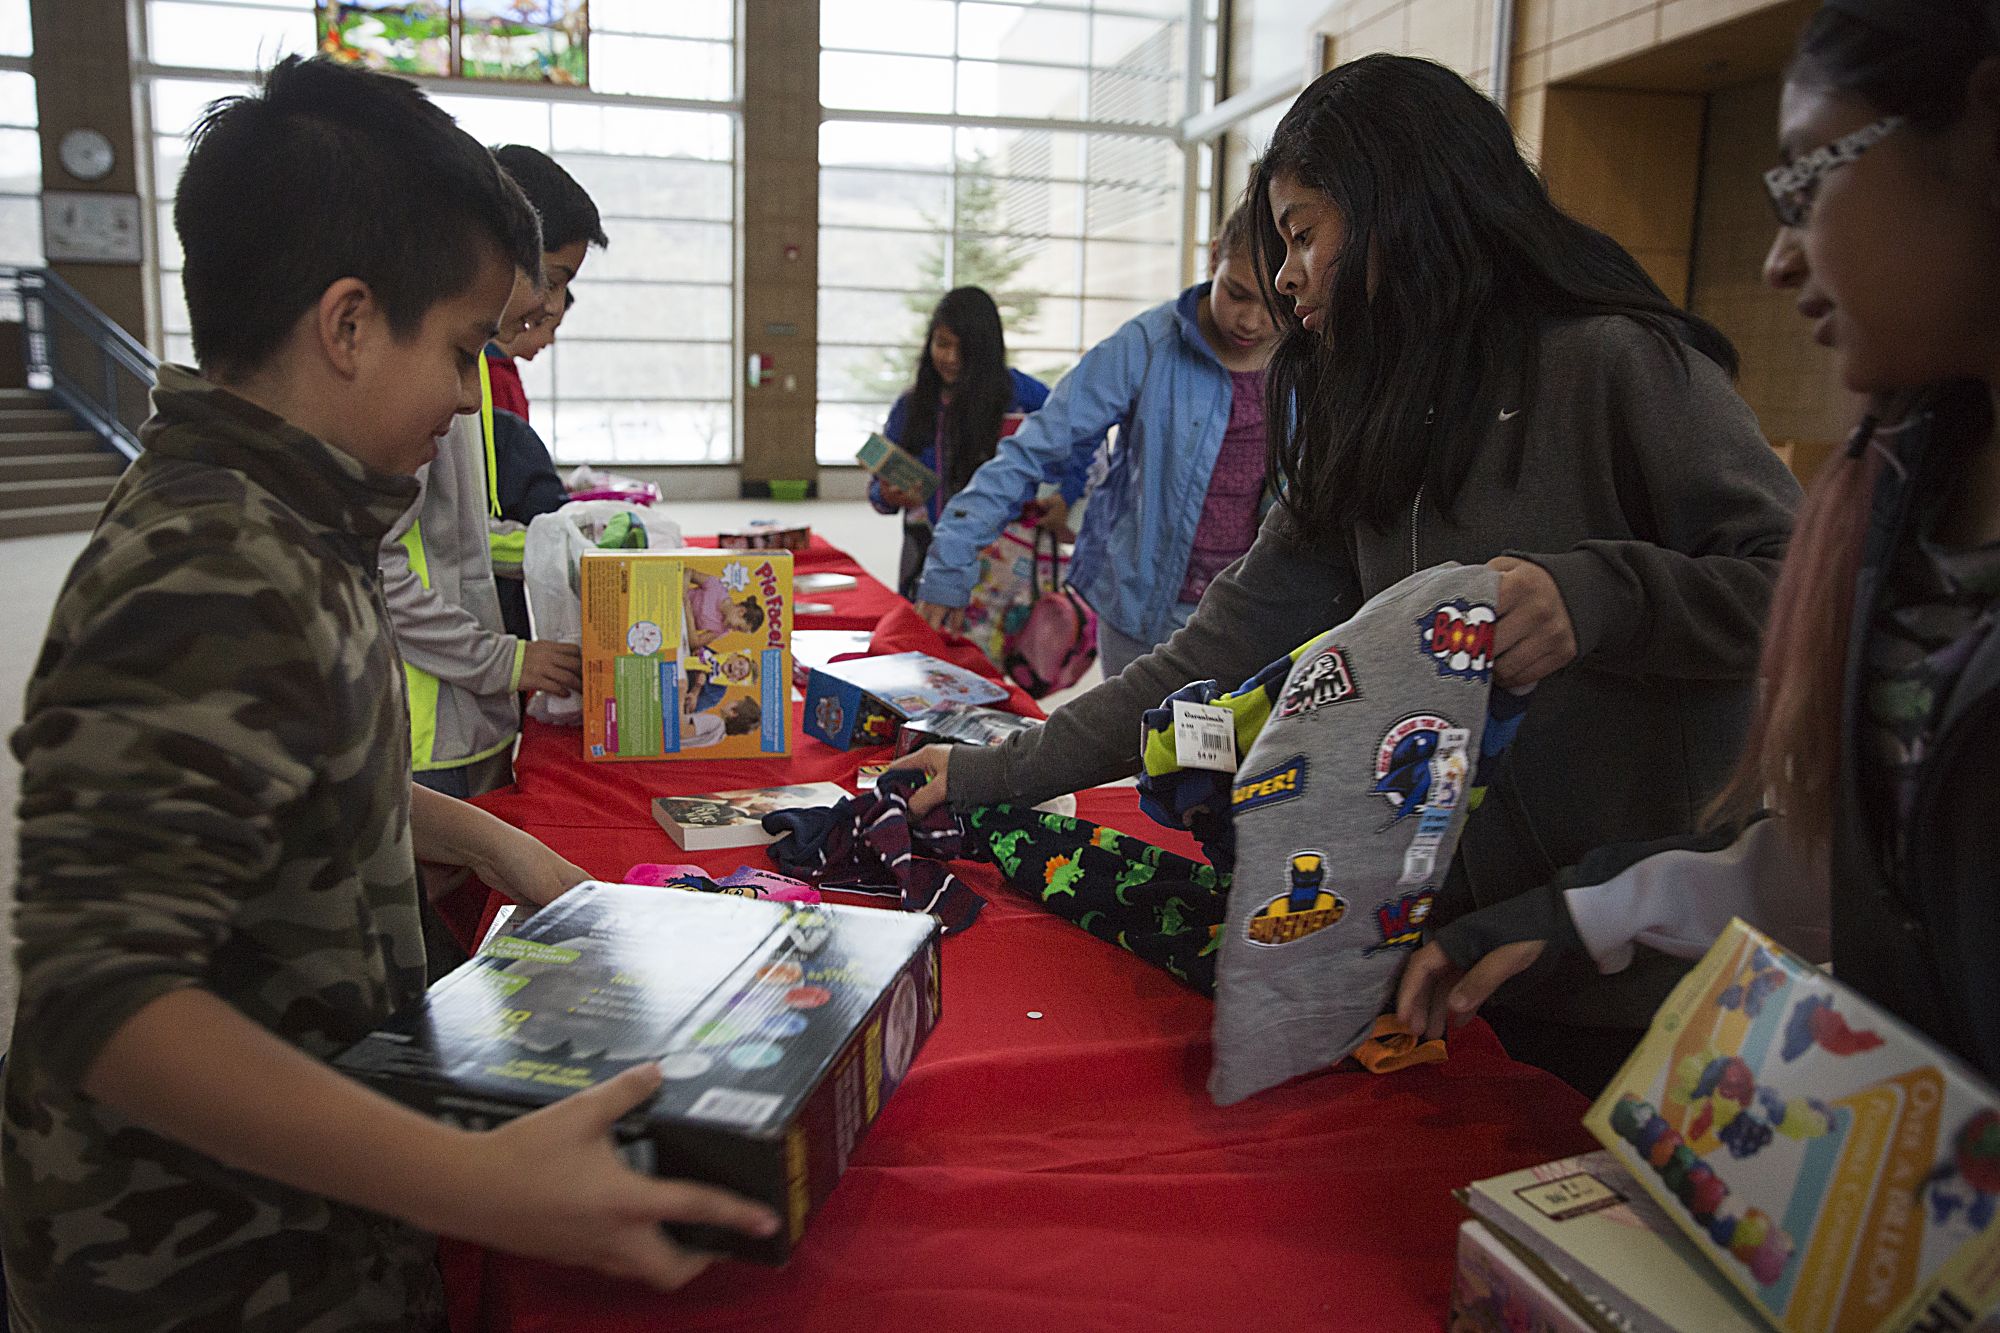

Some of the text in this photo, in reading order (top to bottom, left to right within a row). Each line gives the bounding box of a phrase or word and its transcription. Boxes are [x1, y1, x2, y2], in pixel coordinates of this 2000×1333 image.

[755, 562, 776, 597] Pie
[1431, 611, 1495, 662] BOOM
[1231, 768, 1298, 806] UPER!
